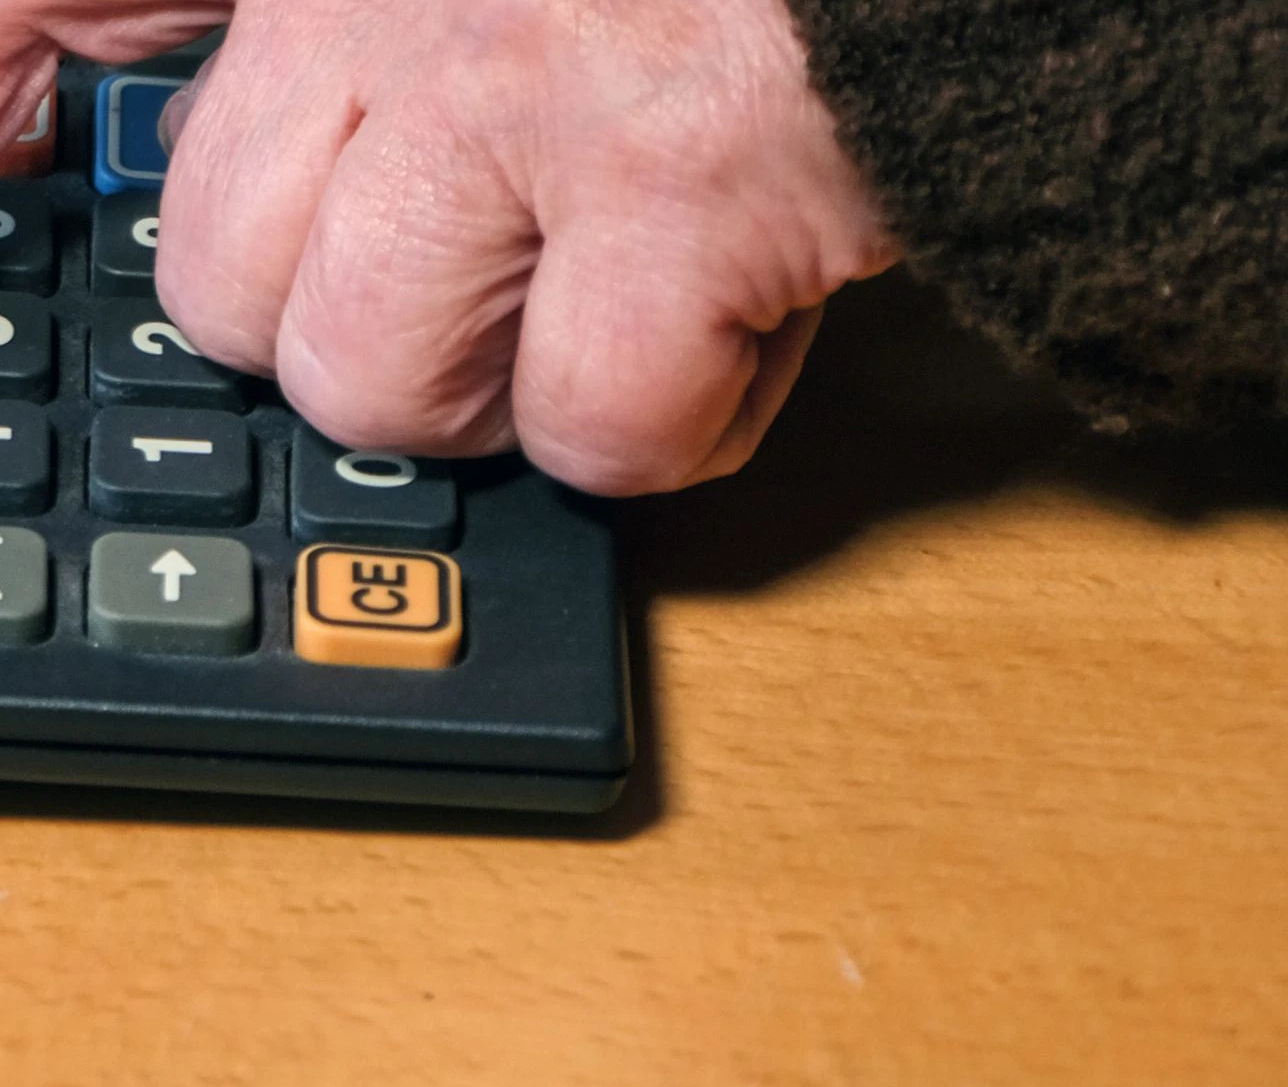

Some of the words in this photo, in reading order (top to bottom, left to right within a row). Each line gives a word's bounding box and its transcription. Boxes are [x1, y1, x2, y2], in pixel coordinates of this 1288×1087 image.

[132, 321, 202, 356] 2
[132, 435, 213, 462] 1
[335, 451, 417, 487] 0
[351, 561, 409, 617] CE
